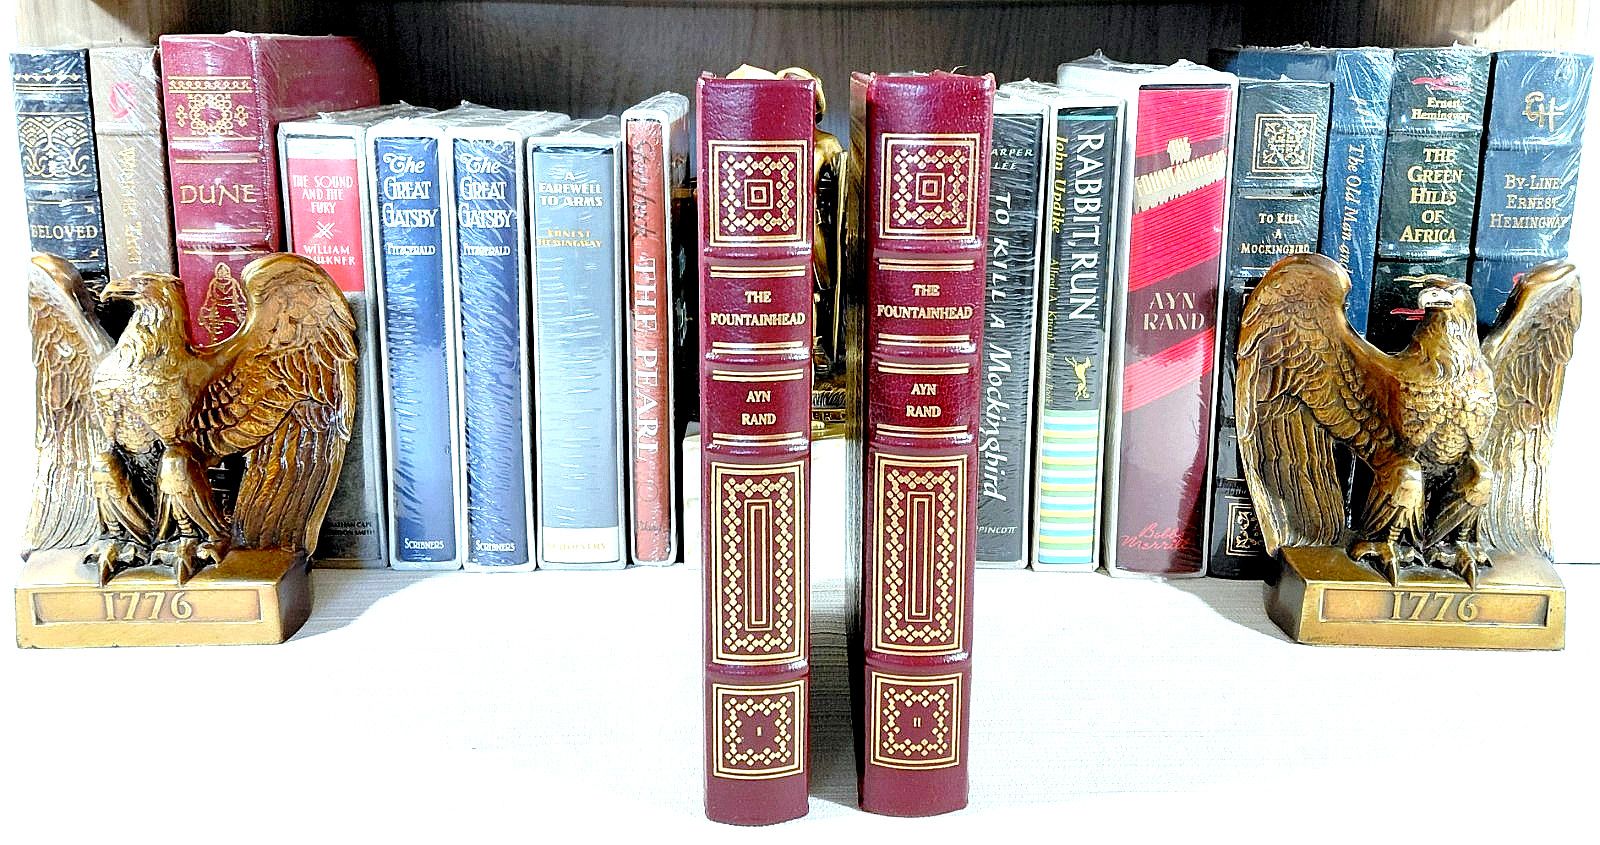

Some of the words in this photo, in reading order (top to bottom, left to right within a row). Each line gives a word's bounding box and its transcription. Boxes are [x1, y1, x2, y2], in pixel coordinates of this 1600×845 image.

[1426, 97, 1461, 109] Ernest
[1411, 108, 1470, 122] Hemingway
[991, 148, 1034, 157] ARPER
[1055, 136, 1069, 171] John
[1167, 137, 1192, 161] THE
[1423, 148, 1458, 163] THE
[382, 153, 425, 174] The
[460, 153, 501, 174] The
[1347, 143, 1365, 172] The
[993, 162, 1017, 170] LEE
[1135, 150, 1227, 198] FOUNTAINHEAD
[292, 175, 309, 189] THE
[314, 175, 353, 189] SOUND
[564, 171, 576, 181] A
[1407, 166, 1464, 184] GREEN
[180, 184, 258, 206] DUNE
[302, 188, 325, 201] AND
[326, 188, 344, 201] THE
[384, 176, 431, 200] GREAT
[460, 177, 507, 200] GREAT
[538, 183, 602, 194] FAREWELL
[1068, 133, 1105, 247] RABBIT,
[1345, 174, 1362, 204] Old
[540, 195, 559, 206] TO
[563, 196, 603, 207] ARMS
[1409, 188, 1457, 205] HILLS
[1505, 194, 1559, 209] ERNEST
[311, 201, 336, 214] FURY
[995, 192, 1012, 225] TO
[1051, 179, 1067, 234] Updike
[383, 203, 440, 228] GATSBY
[458, 203, 514, 228] GATSBY
[1259, 213, 1274, 223] TO
[1276, 213, 1301, 224] KILL
[1341, 205, 1358, 241] Man
[1422, 210, 1446, 224] OF
[1489, 212, 1568, 229] HEMINGWAY
[30, 225, 98, 240] BELOVED
[1272, 229, 1282, 239] A
[1400, 225, 1457, 244] AFRICA
[304, 244, 350, 255] WILLIAM
[386, 243, 436, 256] FITZGERALD
[462, 243, 511, 256] FITZGERALD
[1240, 242, 1310, 255] MOCKINGBIRD
[309, 255, 356, 265] ULKNER
[1338, 242, 1353, 275] and
[991, 237, 1010, 304] KILL
[912, 283, 940, 297] THE
[1068, 253, 1099, 320] RUN
[635, 258, 656, 333] THE
[744, 290, 772, 303] THE
[1149, 292, 1196, 310] AYN
[710, 312, 806, 326] FOUNTAINHEAD
[877, 304, 973, 320] FOUNTAINHEAD
[989, 313, 1006, 329] A
[1143, 312, 1205, 331] RAND
[746, 390, 771, 404] AYN
[910, 383, 937, 396] AYN
[635, 348, 659, 463] PEARL
[906, 405, 942, 418] RAND
[741, 413, 777, 426] RAND
[978, 343, 1012, 501] Mockingbird
[977, 526, 1018, 534] PINCOTT
[404, 538, 444, 551] SCRIBNERS
[475, 540, 515, 552] SCRIBNERS
[103, 591, 193, 621] 1776
[1390, 591, 1479, 622] 1776
